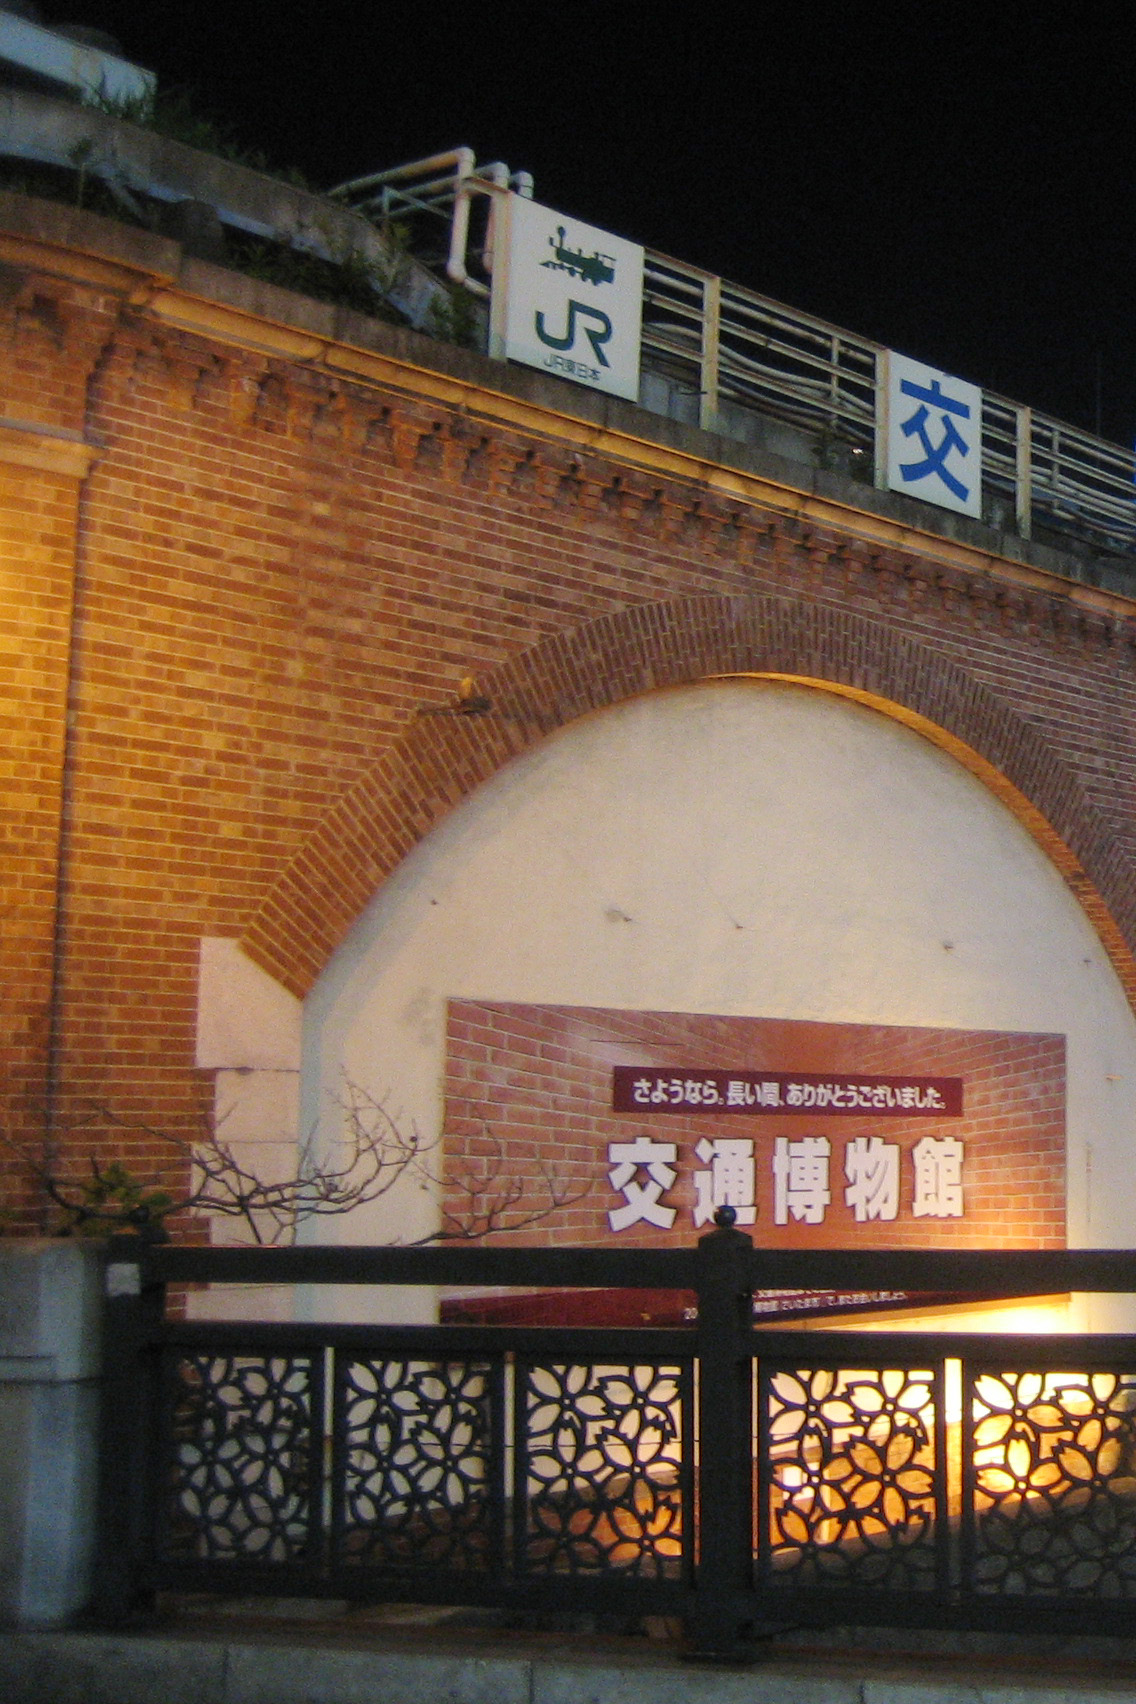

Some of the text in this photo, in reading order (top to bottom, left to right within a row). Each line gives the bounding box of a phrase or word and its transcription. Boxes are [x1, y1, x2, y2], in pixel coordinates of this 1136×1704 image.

[535, 299, 612, 368] JR
[899, 378, 970, 503] 交
[608, 1135, 965, 1233] 交通博物館
